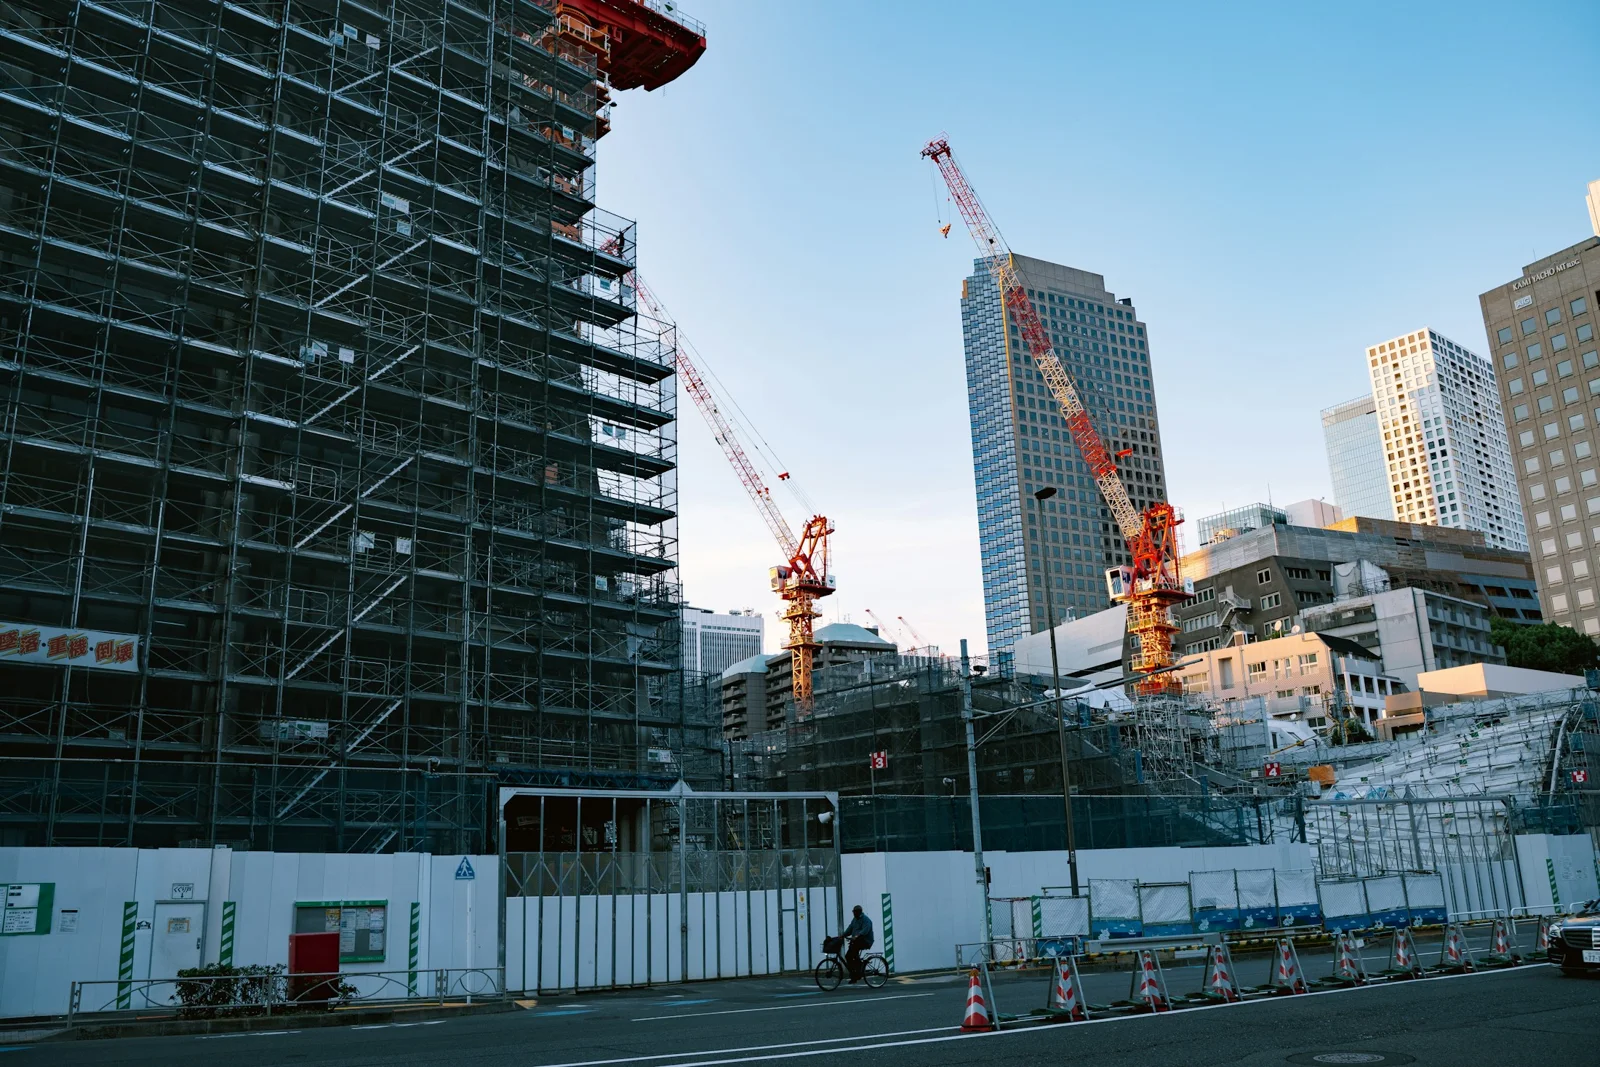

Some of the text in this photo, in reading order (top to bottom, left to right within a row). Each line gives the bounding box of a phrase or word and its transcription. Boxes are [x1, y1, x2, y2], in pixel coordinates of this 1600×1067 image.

[875, 757, 884, 769] 3
[1268, 767, 1278, 777] 4
[1576, 774, 1585, 783] 5
